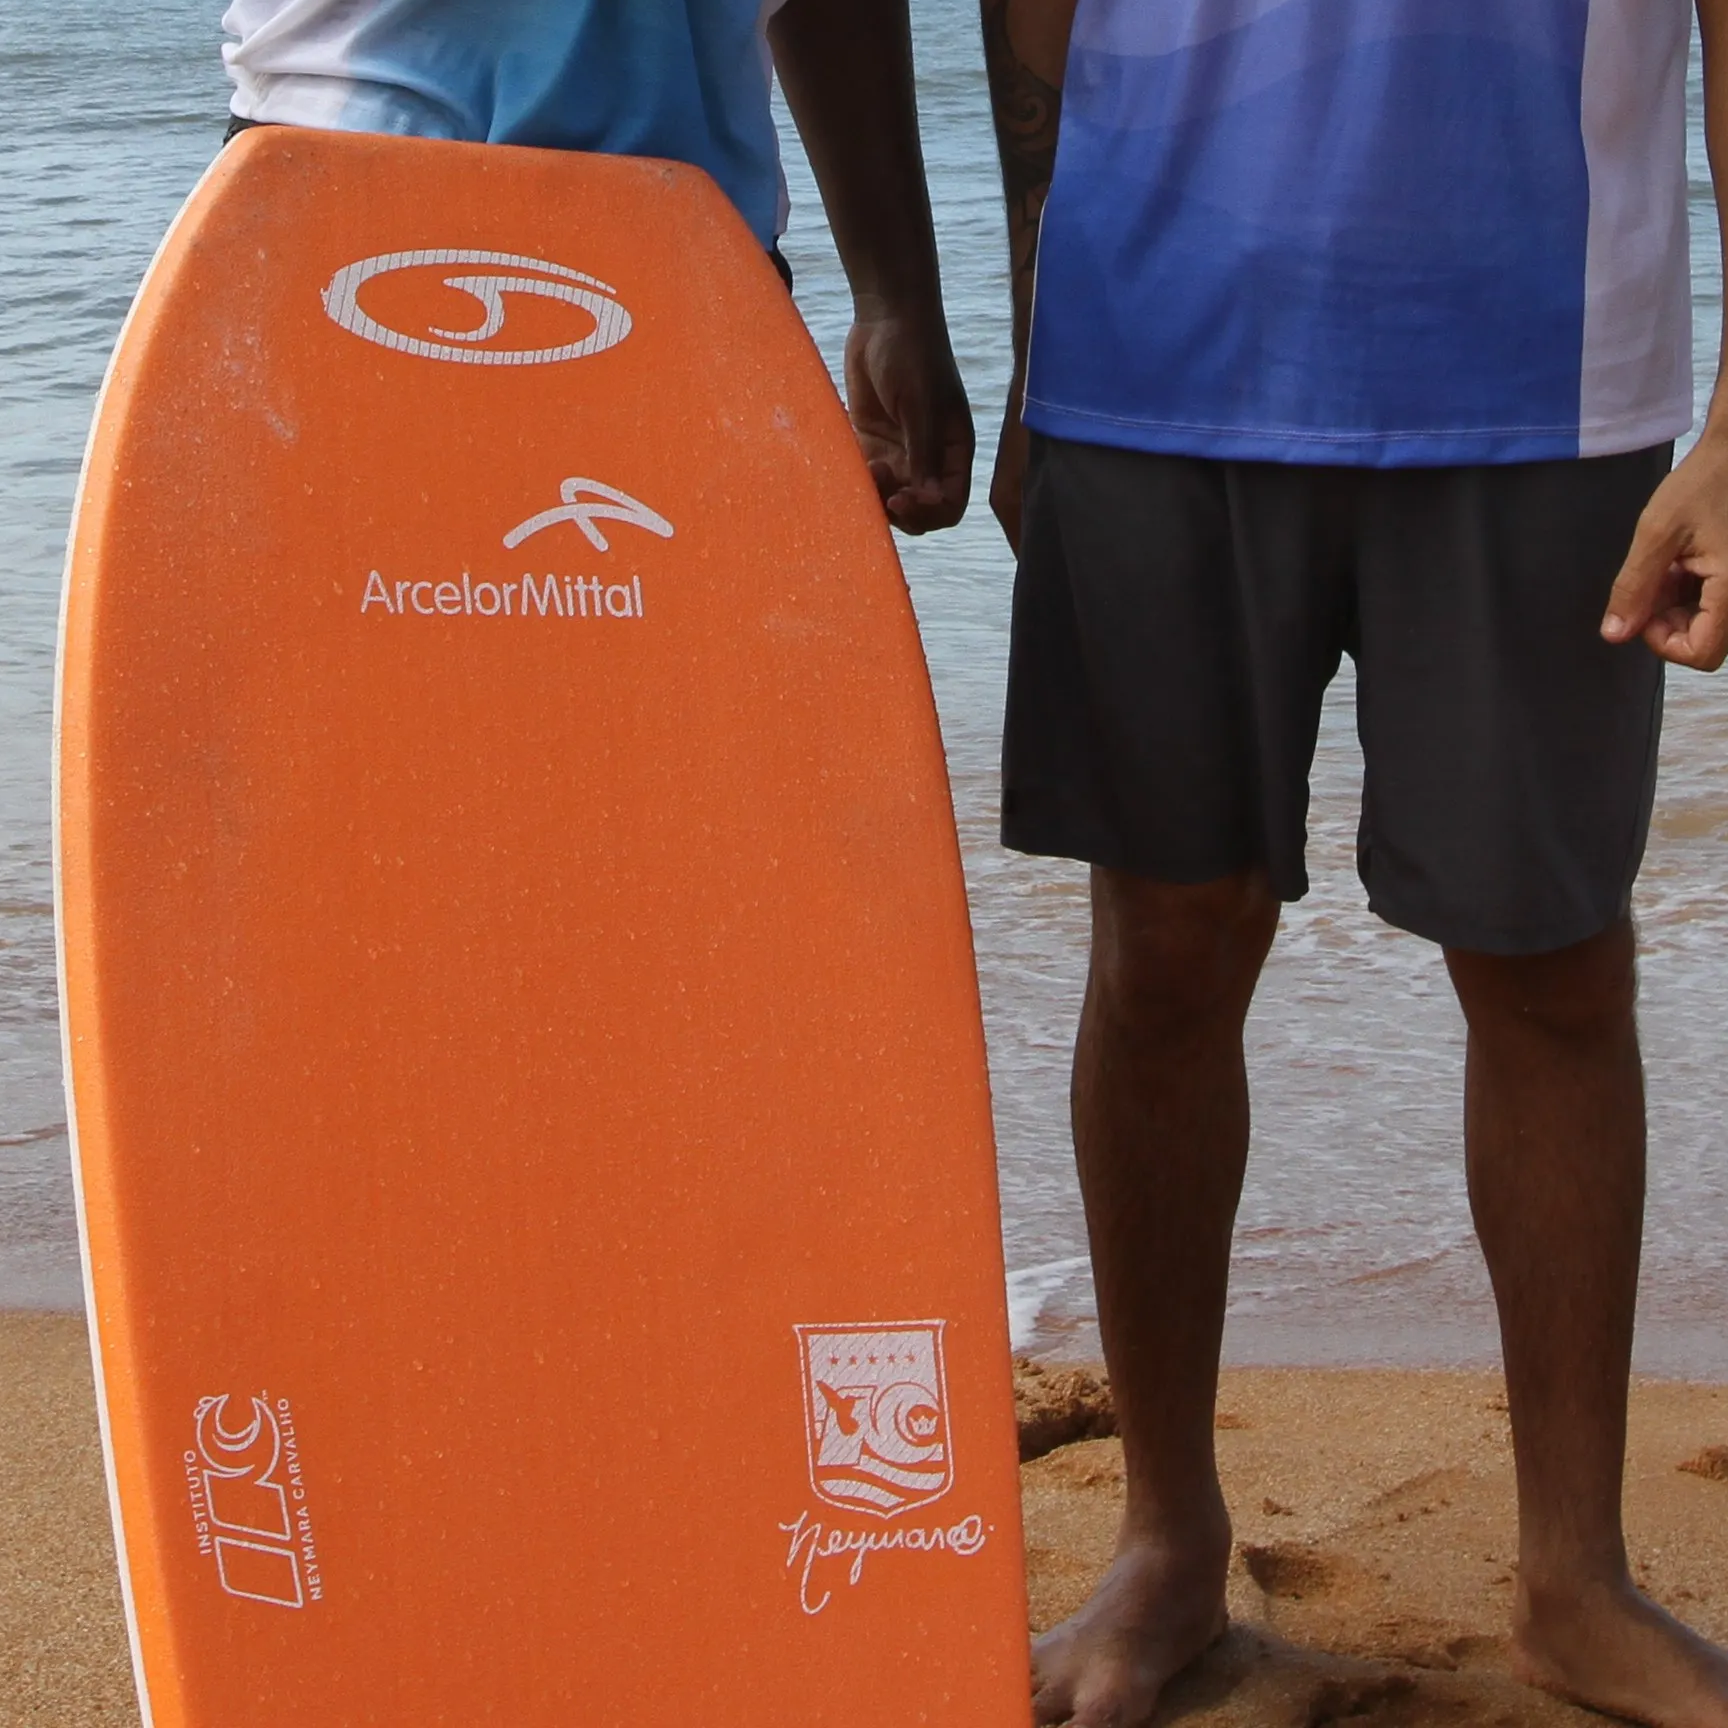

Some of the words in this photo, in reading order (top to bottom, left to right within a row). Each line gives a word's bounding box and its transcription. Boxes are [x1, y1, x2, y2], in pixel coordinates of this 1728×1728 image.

[360, 570, 644, 618] ArcelorMittal
[276, 1398, 306, 1500] CARVALHO
[183, 1449, 212, 1555] INSTITUTO
[292, 1506, 323, 1601] NEYMARA
